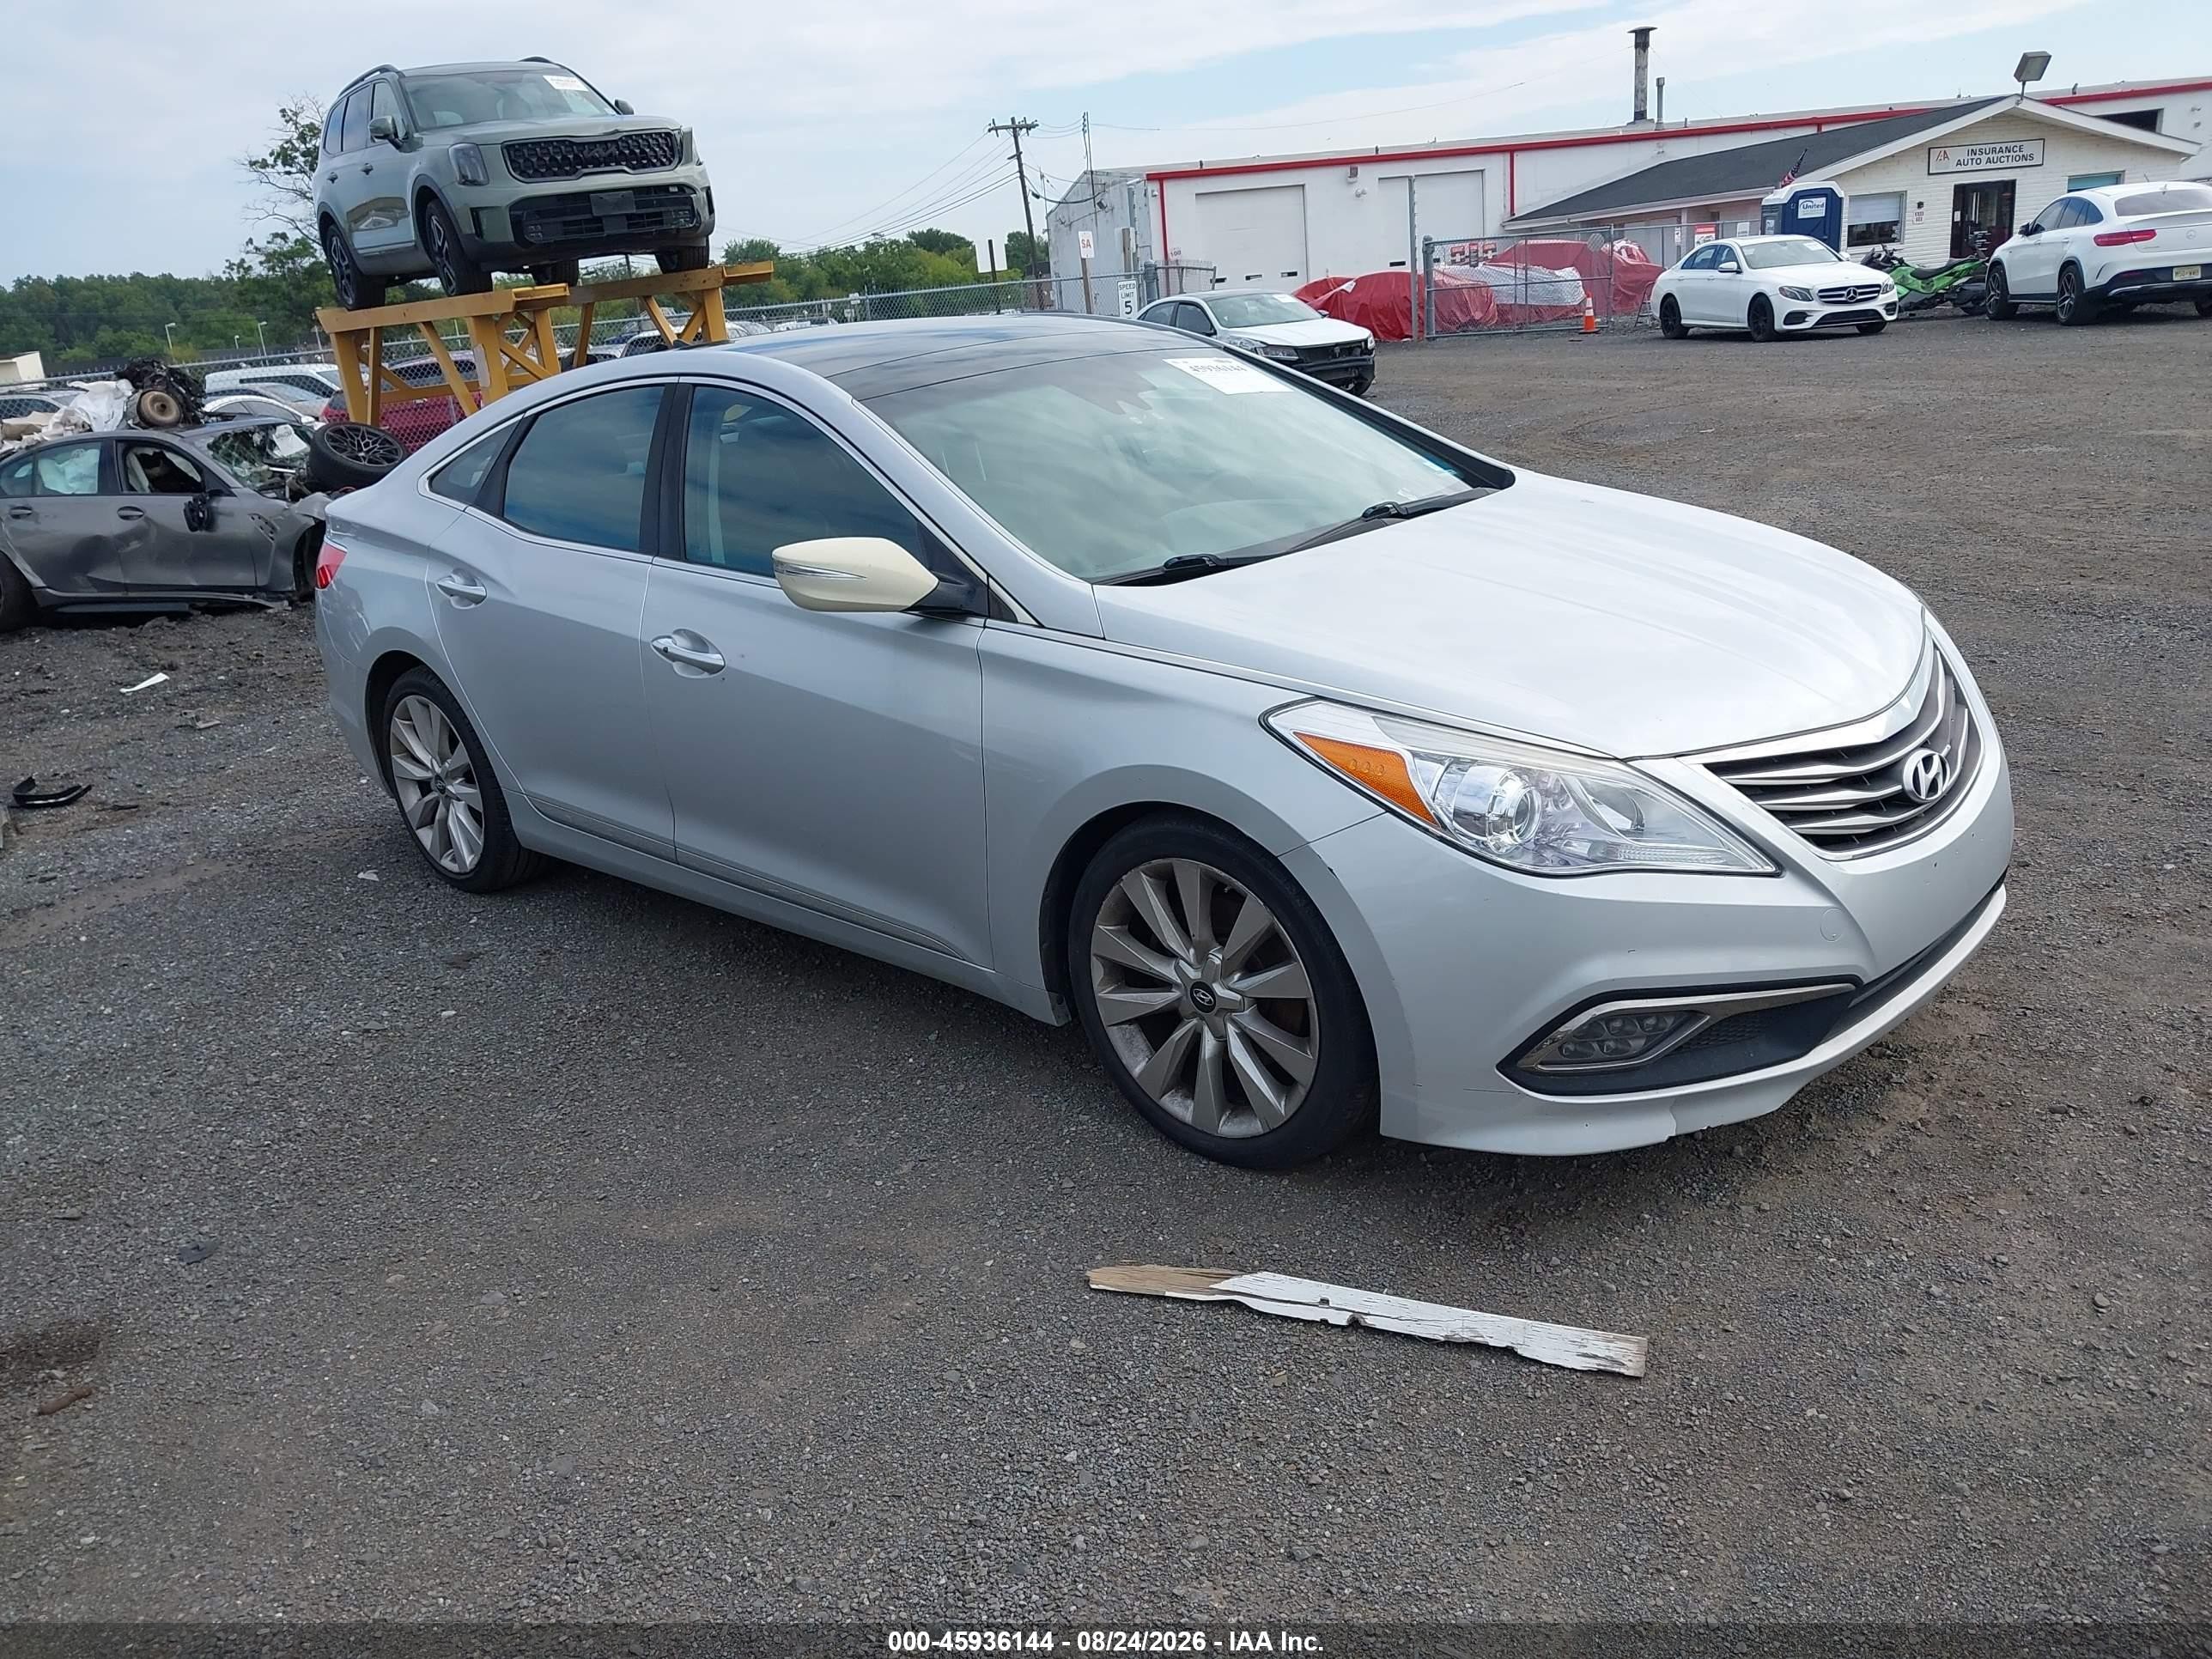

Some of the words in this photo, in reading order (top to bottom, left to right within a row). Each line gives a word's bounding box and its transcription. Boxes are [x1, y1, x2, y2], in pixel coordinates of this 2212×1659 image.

[1966, 144, 2024, 157] INSURANCE
[1955, 157, 1982, 167] AUTO
[1985, 153, 2034, 165] AUCTIONS
[1082, 239, 1091, 249] SA
[1124, 301, 1133, 314] 5
